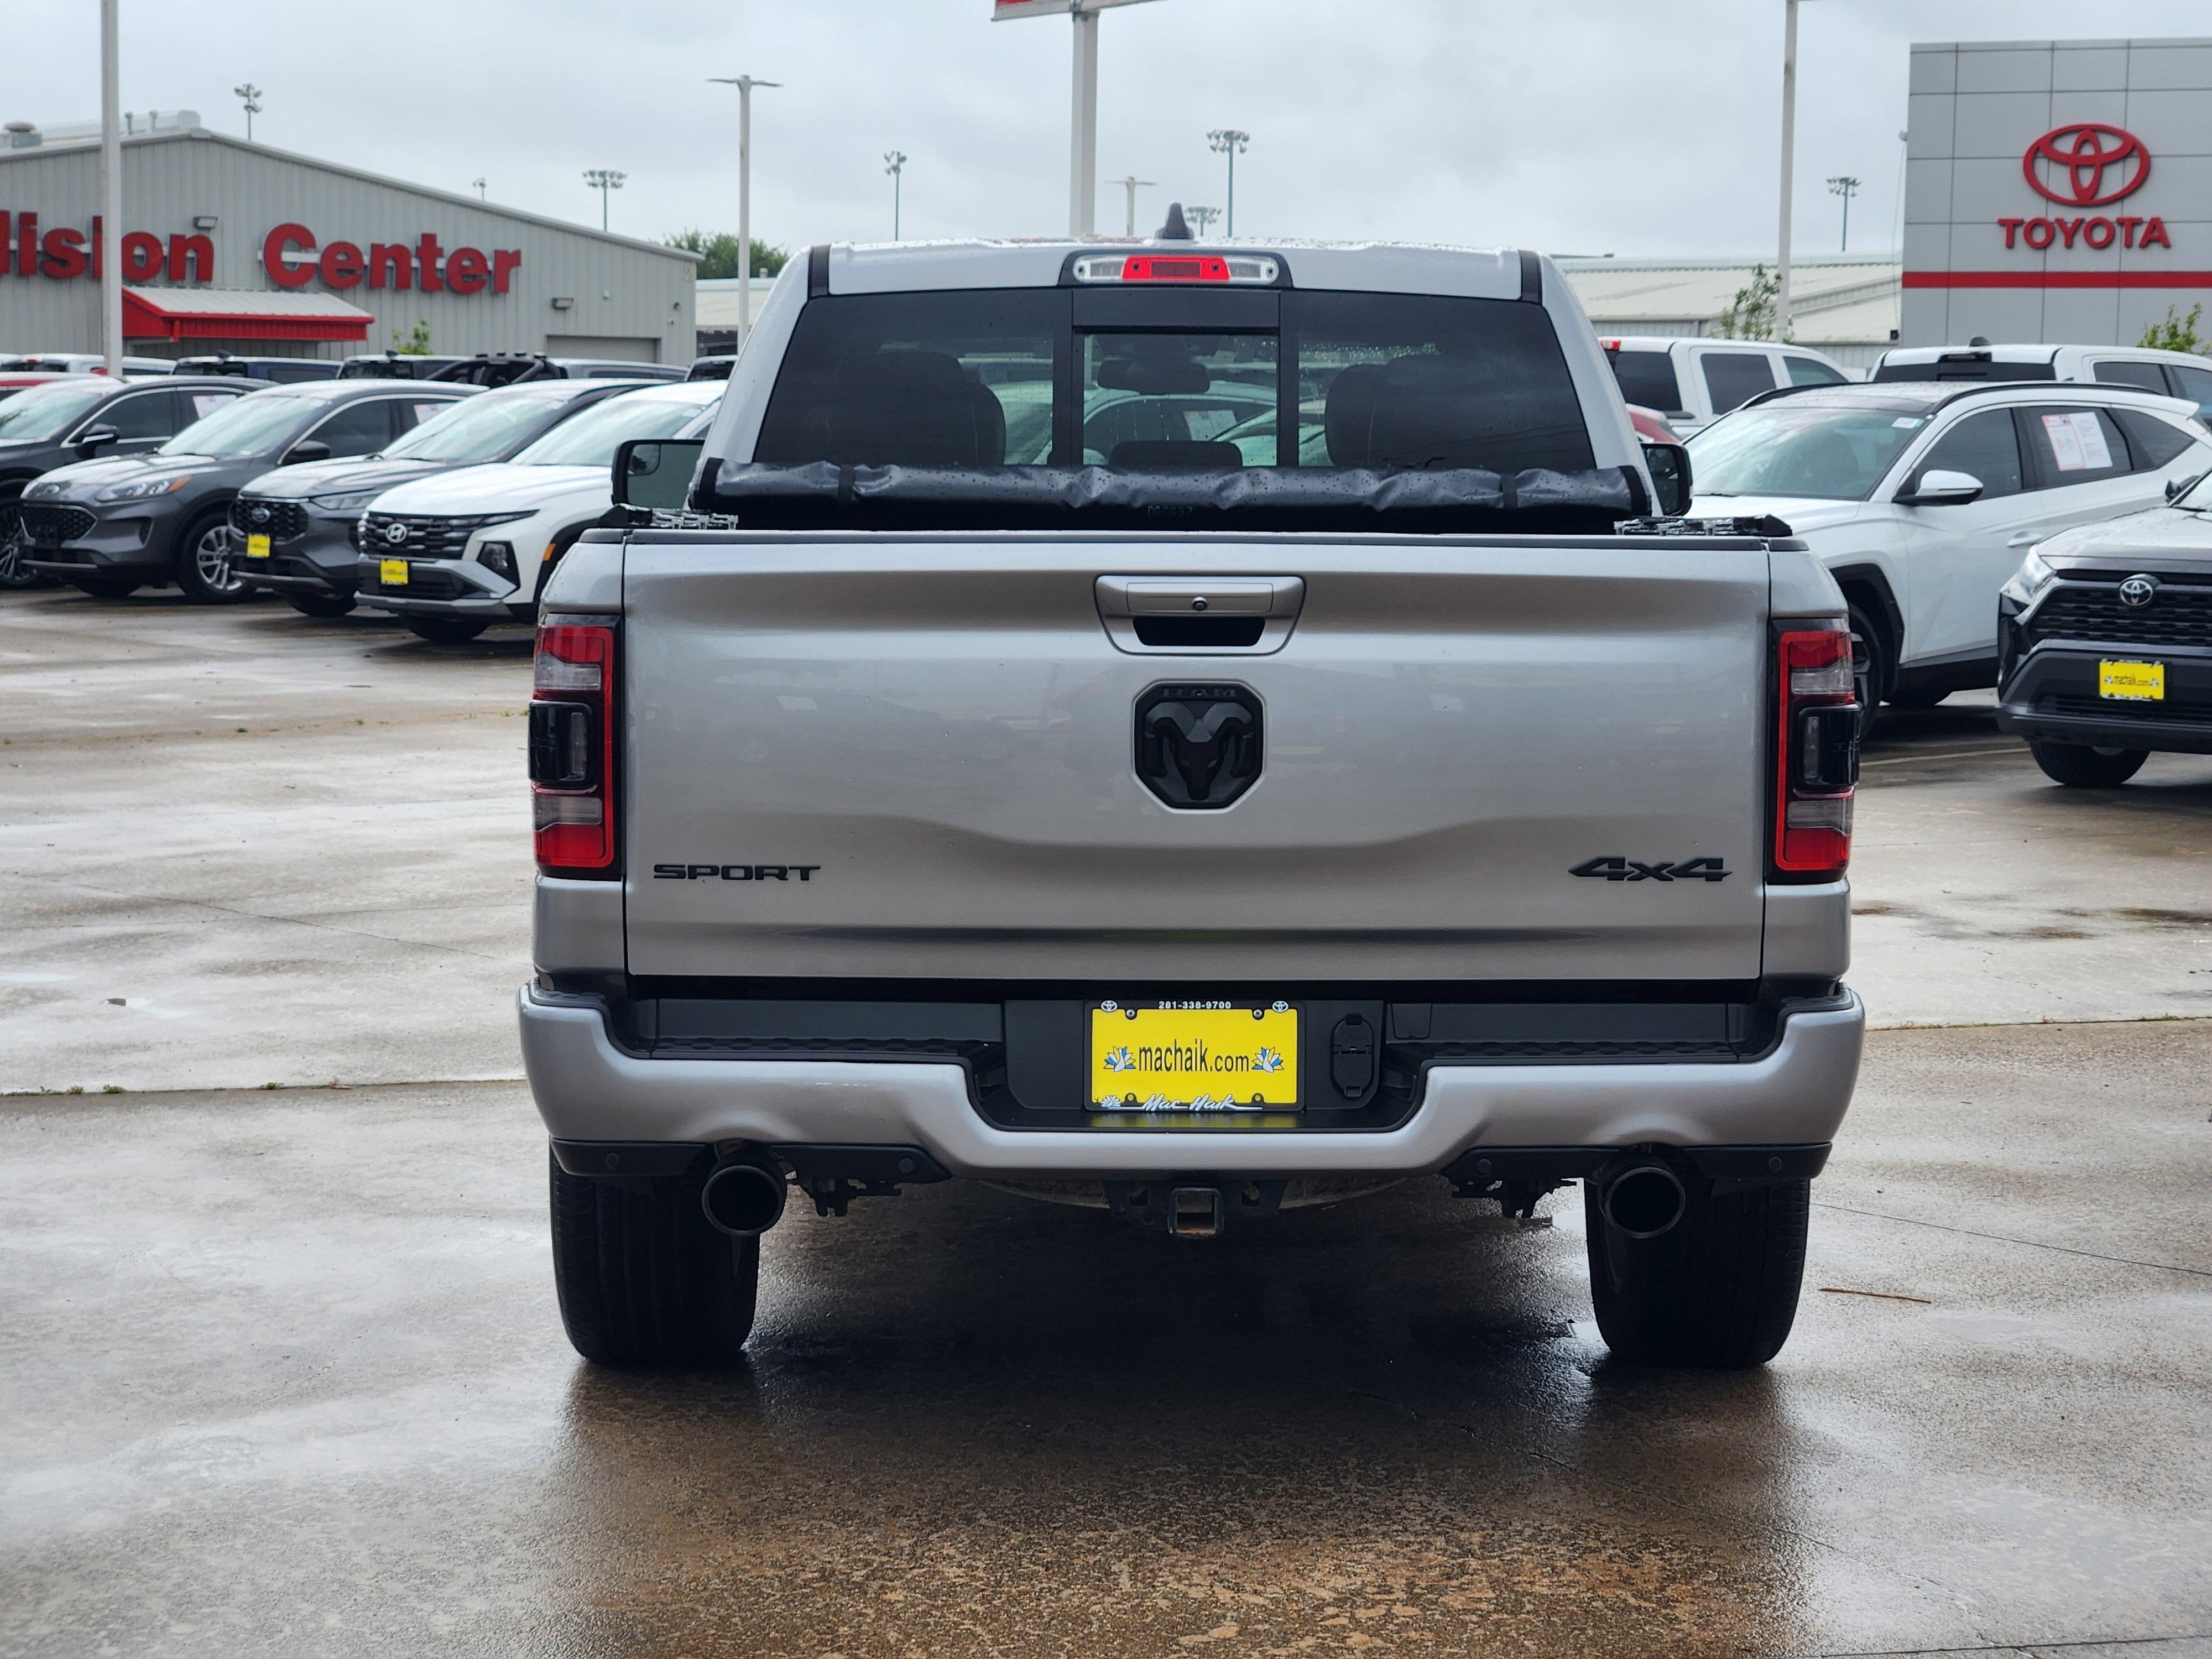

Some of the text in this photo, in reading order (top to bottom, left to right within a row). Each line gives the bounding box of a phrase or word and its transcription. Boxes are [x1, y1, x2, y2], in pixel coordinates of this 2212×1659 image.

[1997, 216, 2171, 249] TOYOTA
[263, 223, 521, 294] Center
[1162, 687, 1237, 698] RAM
[654, 864, 821, 881] SPORT
[1158, 1000, 1232, 1009] 281-338-9700
[1139, 1038, 1249, 1072] machaik.com
[1142, 1093, 1235, 1112] Mac Haik
